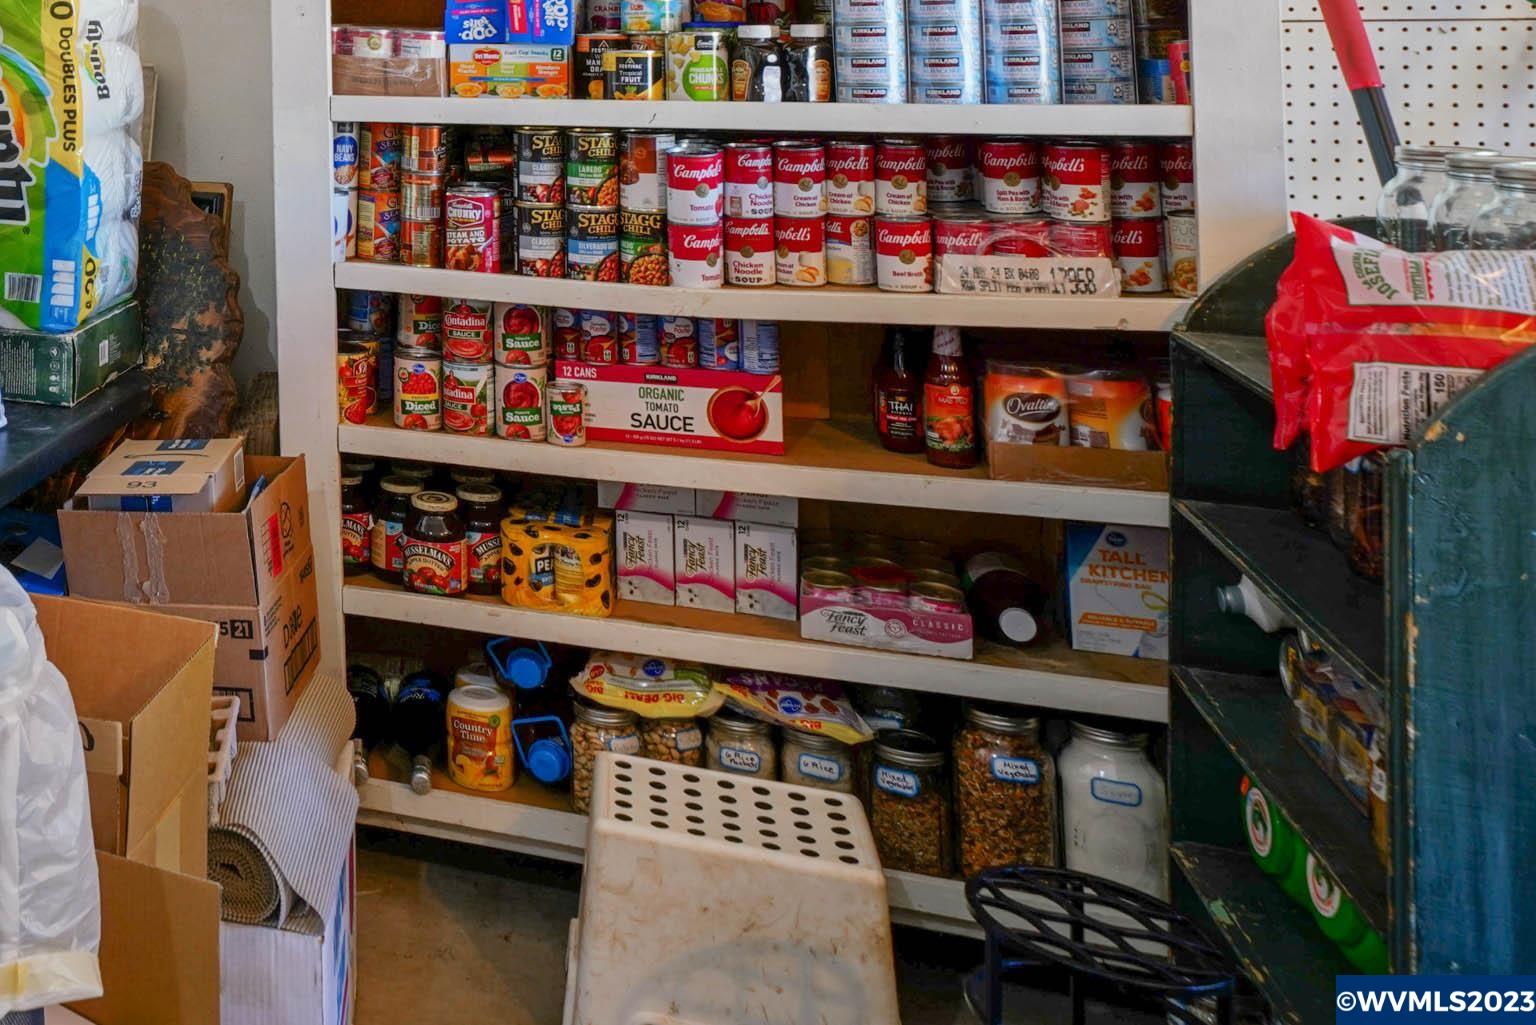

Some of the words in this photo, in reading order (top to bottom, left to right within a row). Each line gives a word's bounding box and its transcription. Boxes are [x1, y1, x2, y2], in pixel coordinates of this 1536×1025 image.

[552, 48, 562, 59] 12
[59, 26, 77, 105] DOUBLES
[62, 108, 77, 152] PLUS
[336, 143, 354, 153] NAVY
[334, 152, 355, 162] BEANS
[578, 165, 602, 173] LAREDO
[447, 207, 482, 219] CHUNKY
[469, 230, 485, 238] AND
[732, 261, 764, 269] Chicken
[733, 267, 763, 276] Noodle
[445, 314, 486, 327] Contadina
[452, 330, 476, 338] SAUCE
[505, 337, 540, 349] Sauce
[562, 365, 572, 377] 12
[573, 366, 597, 379] CANS
[1401, 370, 1410, 396] Facts
[1434, 373, 1444, 395] 150
[638, 386, 685, 402] ORGANIC
[405, 400, 436, 412] Diced
[552, 403, 581, 413] Paste
[645, 401, 679, 414] TOMATO
[887, 400, 913, 412] THAI
[505, 412, 540, 423] Sauce
[630, 412, 695, 433] SAUCE
[1399, 395, 1412, 441] Nutrition
[126, 478, 159, 489] 93
[617, 511, 625, 523] 12
[677, 518, 686, 529] 12
[738, 525, 747, 534] 12
[625, 534, 638, 570] Fancy
[635, 535, 647, 563] Feast
[685, 539, 699, 577] Fancy
[695, 542, 708, 572] Feast
[746, 543, 759, 583] Fancy
[756, 547, 769, 577] Feast
[1098, 548, 1147, 566] TALL
[1088, 565, 1171, 585] KITCHEN
[821, 608, 865, 626] Fancy
[231, 621, 253, 638] 21
[830, 621, 869, 637] Feast
[662, 693, 685, 705] BIG
[453, 719, 493, 737] Country
[460, 729, 486, 743] Time
[880, 770, 907, 783] Mixed
